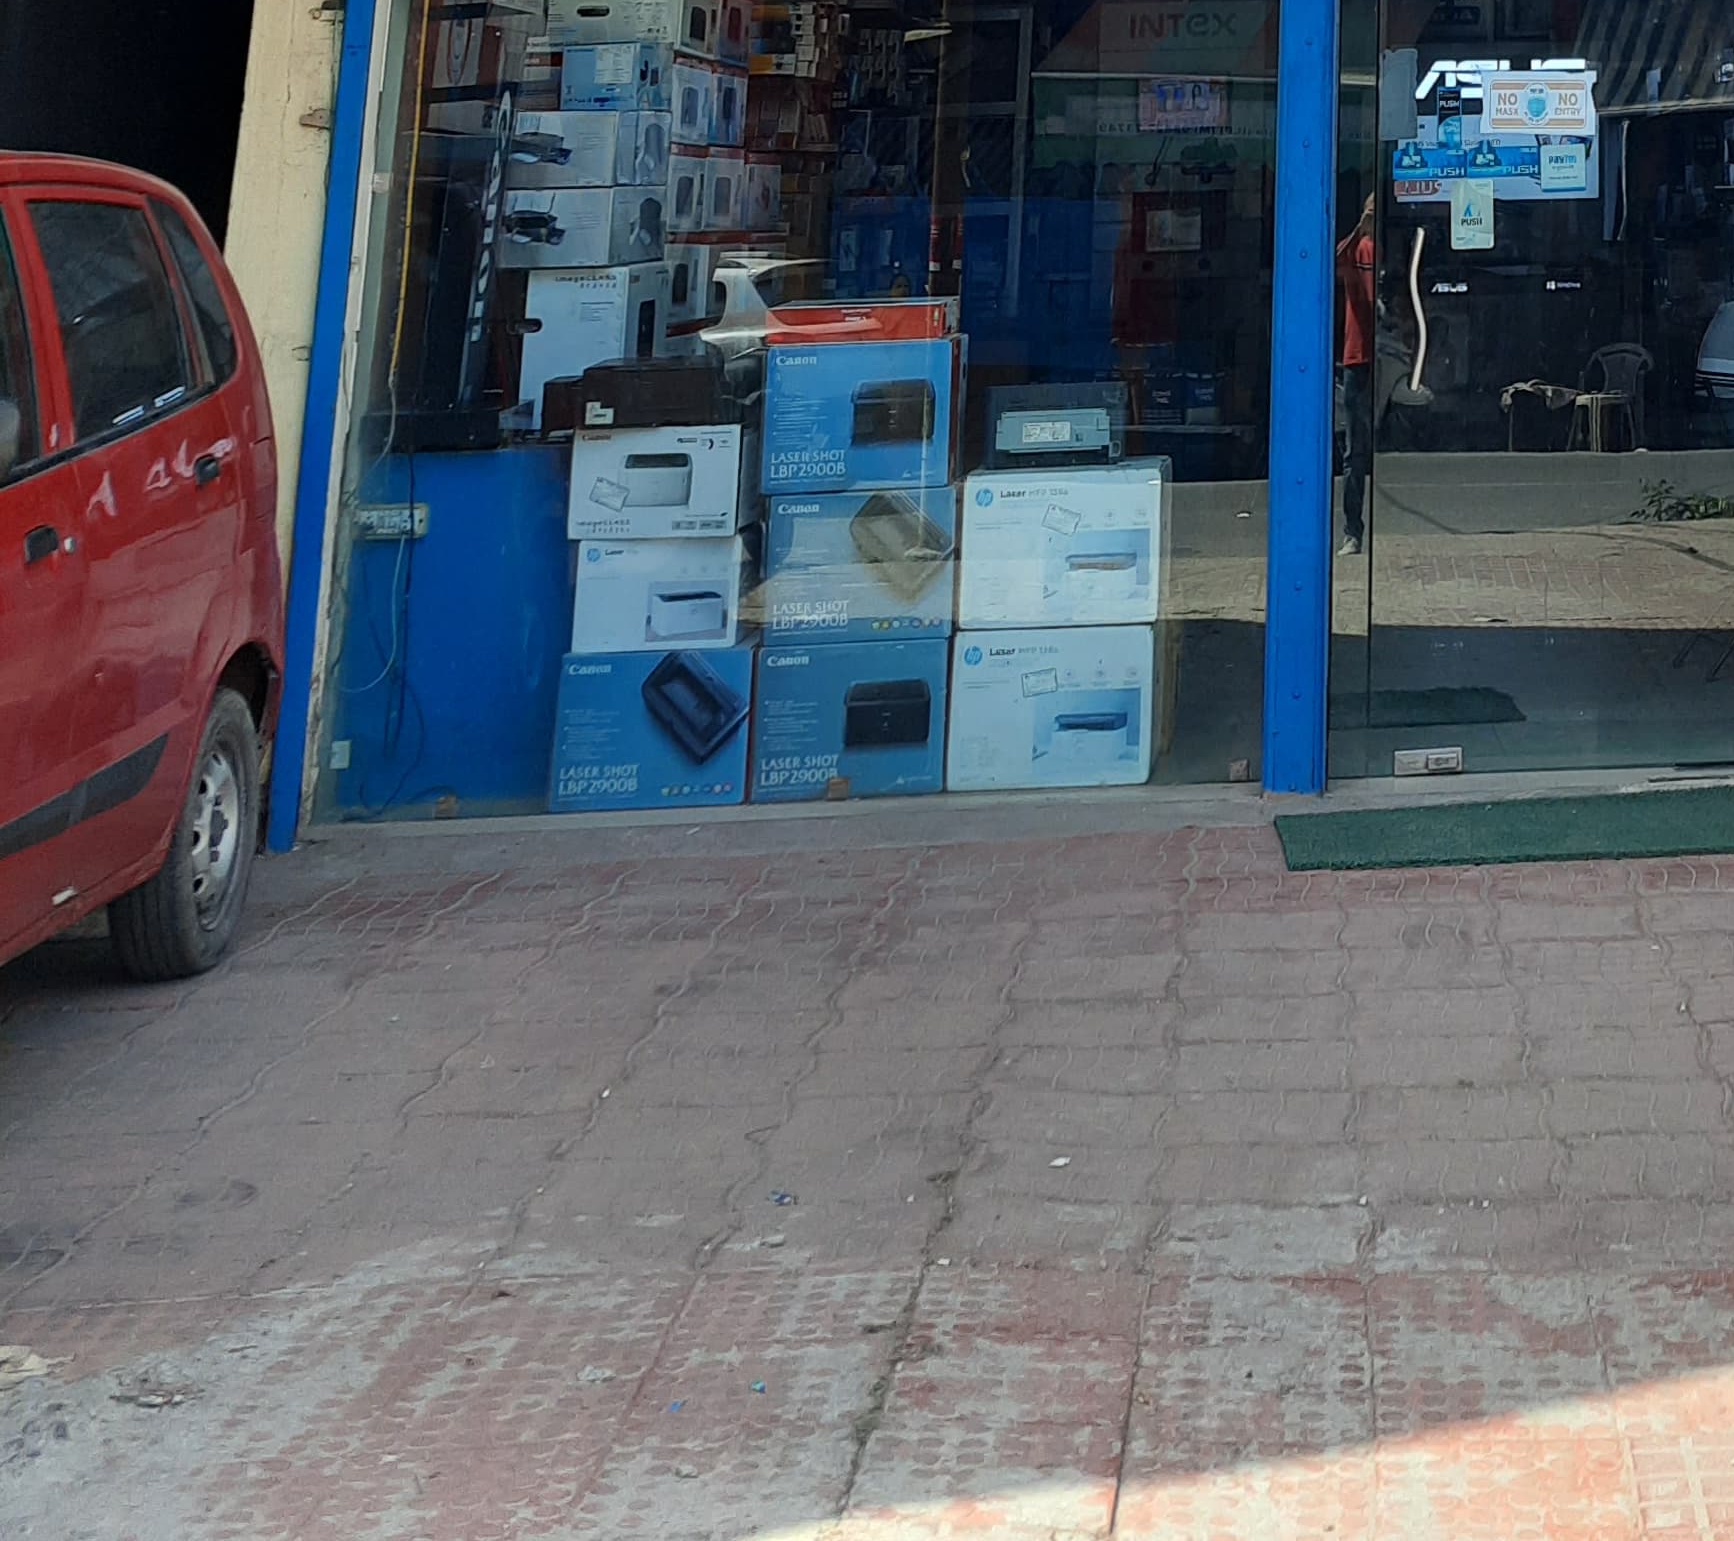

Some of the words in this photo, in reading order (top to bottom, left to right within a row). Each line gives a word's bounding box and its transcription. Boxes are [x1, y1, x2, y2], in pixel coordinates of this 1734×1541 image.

[1415, 58, 1587, 101] AS
[1497, 92, 1519, 106] NO
[1557, 92, 1579, 106] NO
[1428, 166, 1466, 178] PUSH
[1503, 164, 1540, 176] PUSH
[1461, 217, 1483, 228] PUSH
[775, 354, 818, 367] Canon
[770, 451, 811, 465] LASER
[812, 449, 847, 463] SHOT
[999, 488, 1027, 500] Laser
[777, 502, 820, 515] Canon
[772, 601, 812, 616] LASER
[814, 599, 849, 614] SHOT
[766, 652, 810, 667] Canon
[567, 661, 613, 676] Canon
[760, 756, 802, 771] LASER
[804, 754, 839, 769] SHOT
[559, 764, 601, 780] LASER
[603, 763, 641, 779] SHOT
